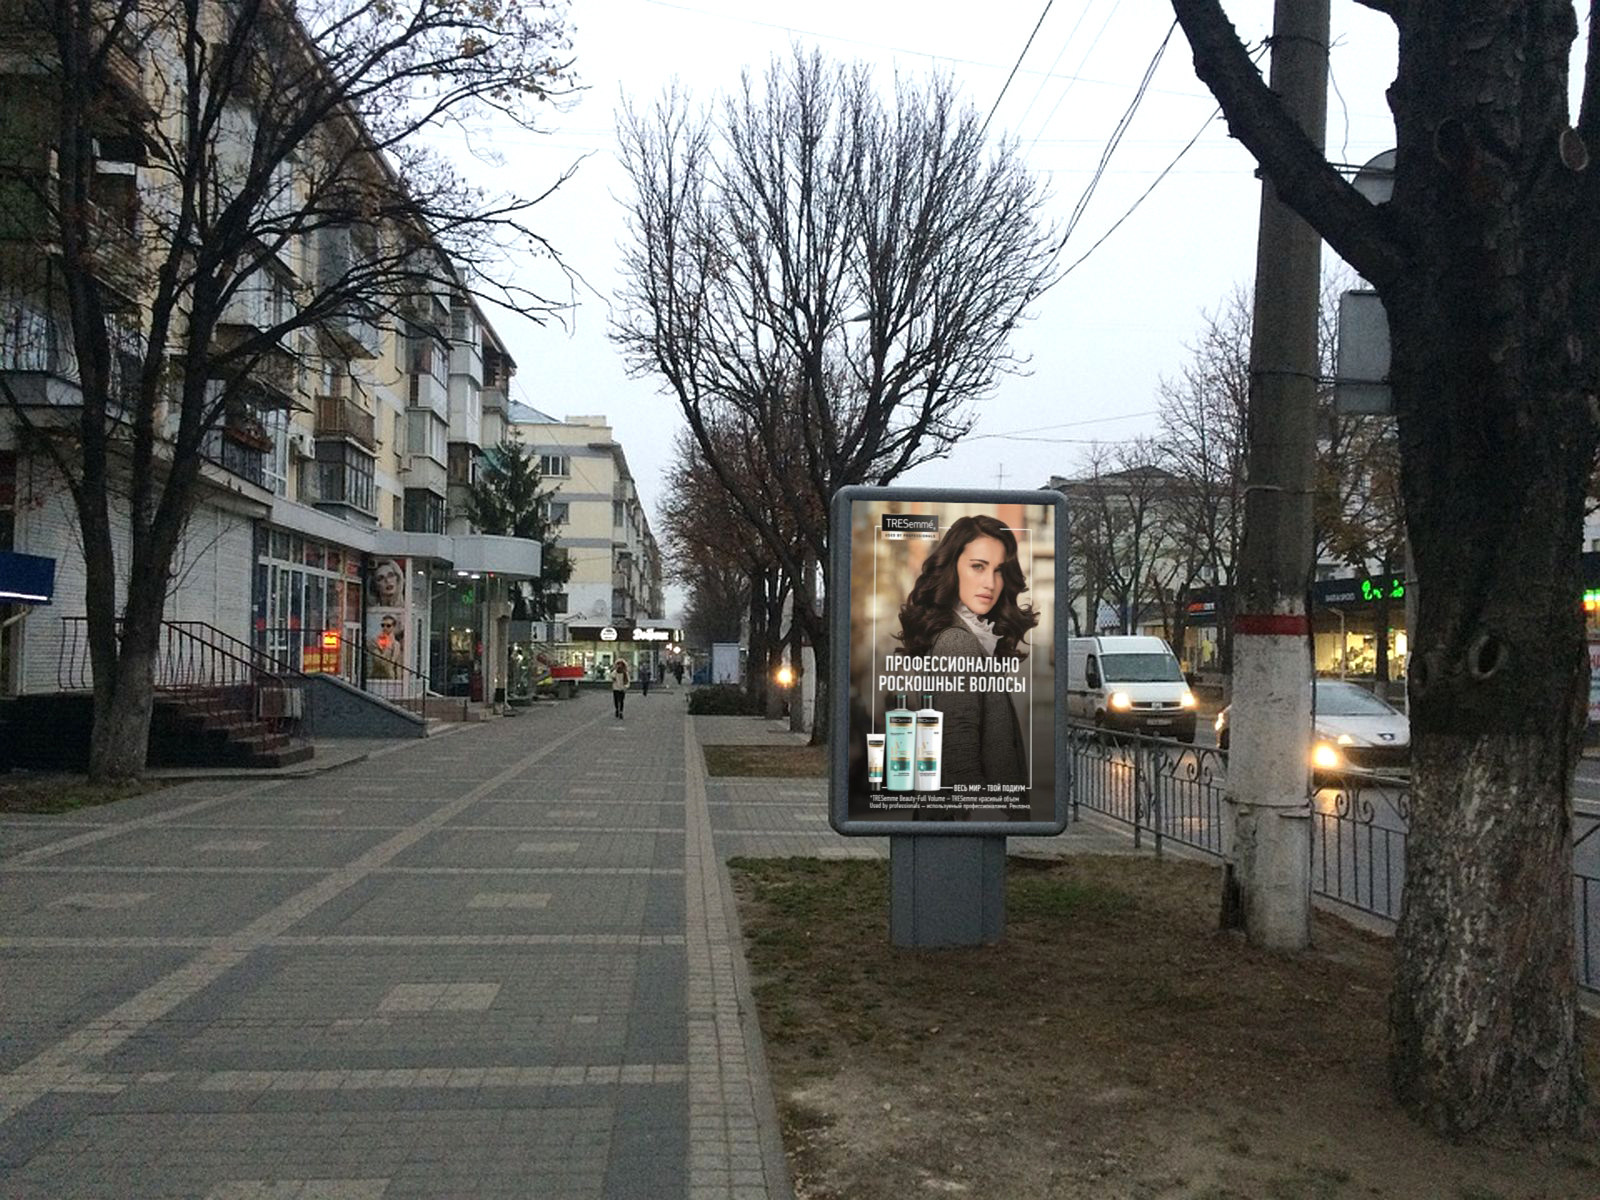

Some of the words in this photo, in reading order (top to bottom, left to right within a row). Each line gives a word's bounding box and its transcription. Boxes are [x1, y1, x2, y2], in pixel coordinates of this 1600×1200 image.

[885, 655, 1020, 673] ПРОФЕССИОНАЛЬНО
[878, 675, 966, 692] РОСКОШНЫЕ
[969, 676, 1026, 692] ВОЛОСЫ
[953, 784, 968, 792] ВЕСЬ
[968, 784, 981, 792] МИР
[987, 783, 1001, 792] ТВОЙ
[1002, 784, 1026, 793] ПОДИУМ
[928, 794, 945, 802] Volume
[882, 802, 888, 810] by
[889, 802, 921, 810] professionals
